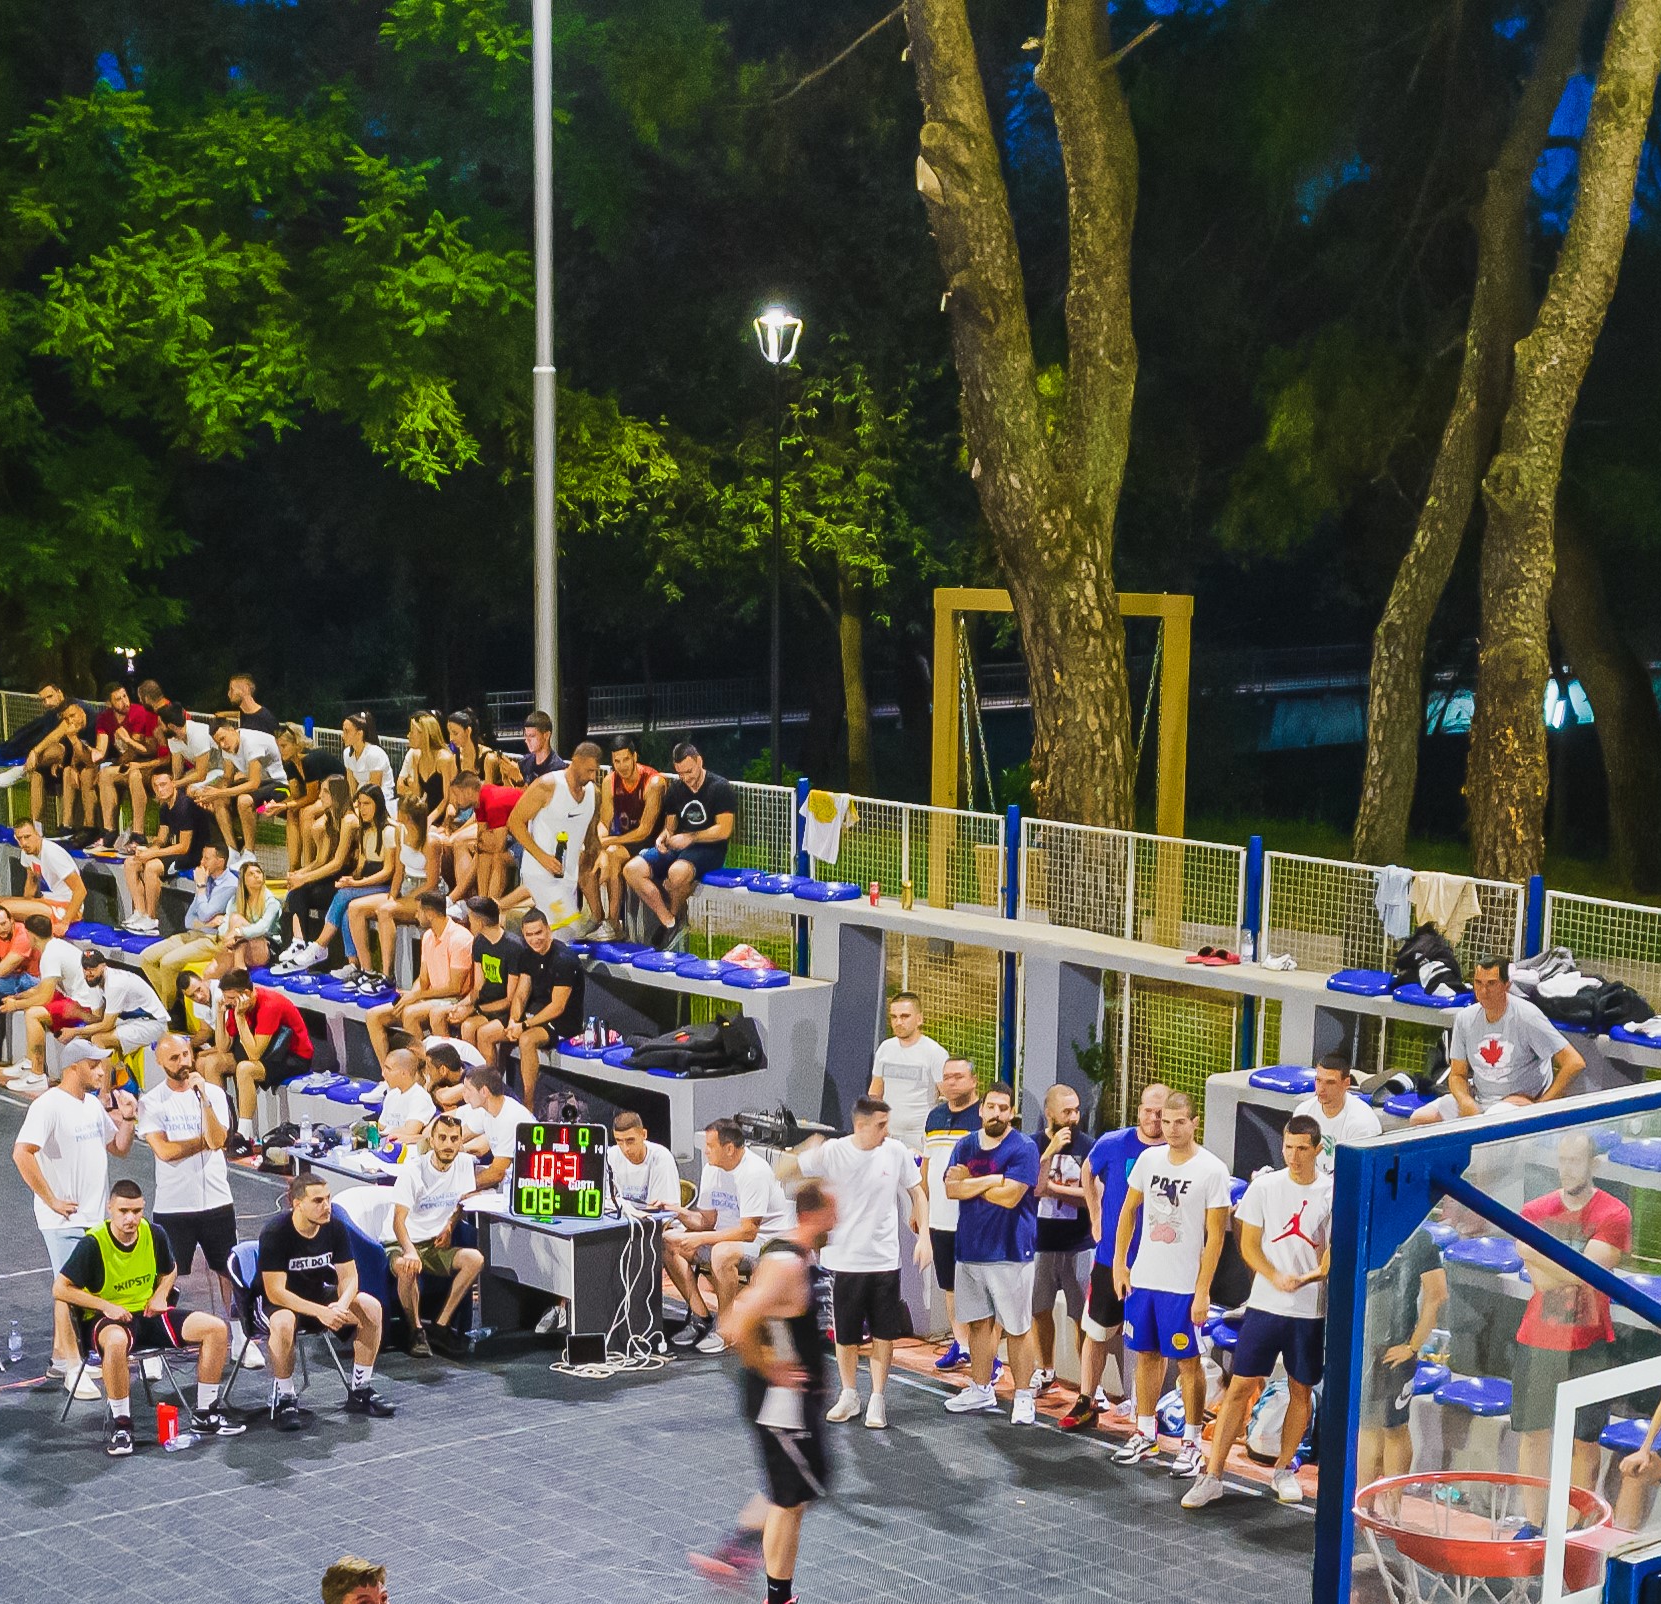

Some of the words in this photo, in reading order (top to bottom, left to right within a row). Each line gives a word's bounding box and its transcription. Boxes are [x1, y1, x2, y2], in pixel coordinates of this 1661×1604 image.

[533, 1126, 544, 1145] 0
[578, 1128, 590, 1147] 0
[578, 1189, 600, 1216] 10
[311, 1257, 323, 1267] DO
